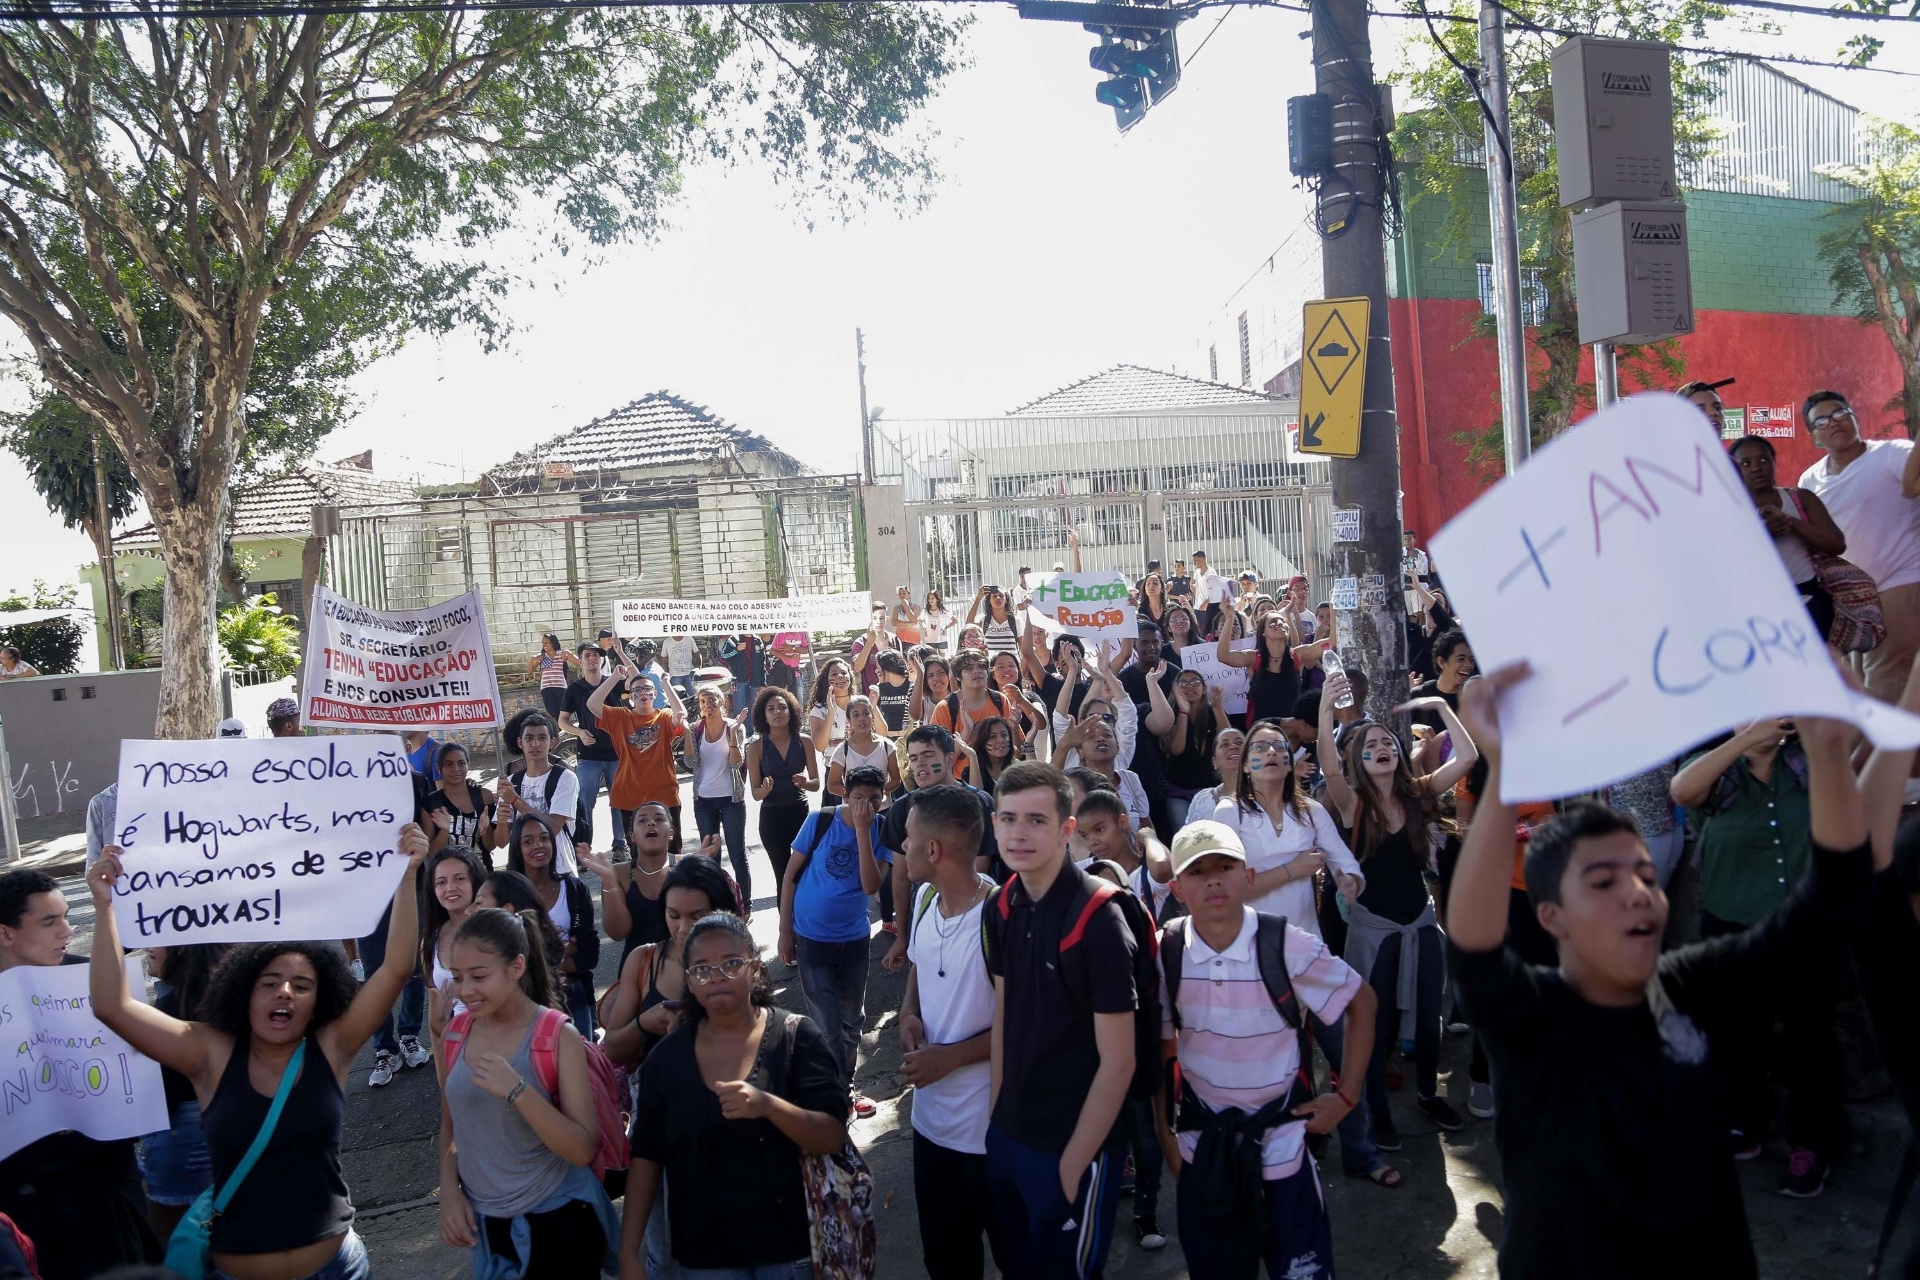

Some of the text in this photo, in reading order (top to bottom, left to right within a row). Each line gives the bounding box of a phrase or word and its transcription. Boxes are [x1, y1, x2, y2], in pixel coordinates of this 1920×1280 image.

[1770, 407, 1792, 421] ALUGA
[1750, 426, 1793, 438] 2236-0101
[878, 526, 896, 536] 304
[1149, 523, 1162, 531] 304
[622, 602, 639, 611] NÃO
[641, 602, 667, 611] ACENO
[728, 603, 749, 611] COLO
[622, 614, 647, 622] ODEIO
[648, 613, 683, 621] POLITICO
[759, 612, 774, 620] QUE
[424, 617, 443, 636] SEU
[662, 624, 669, 633] E
[670, 624, 688, 633] PRO
[690, 623, 709, 632] MEU
[711, 623, 735, 632] POVO
[737, 623, 748, 631] SE
[749, 622, 786, 631] MANTER
[339, 631, 356, 649] SR.
[324, 647, 366, 679] TENHA
[323, 678, 470, 704] E NOS CONSULTE!!
[311, 700, 490, 722] ALUNOS DA REDE PÚBLICA DE ENSINO
[252, 742, 359, 782] escola
[366, 751, 408, 779] não
[117, 802, 395, 859] é Hogwarts, mas
[291, 850, 326, 877] de
[339, 848, 394, 871] ser
